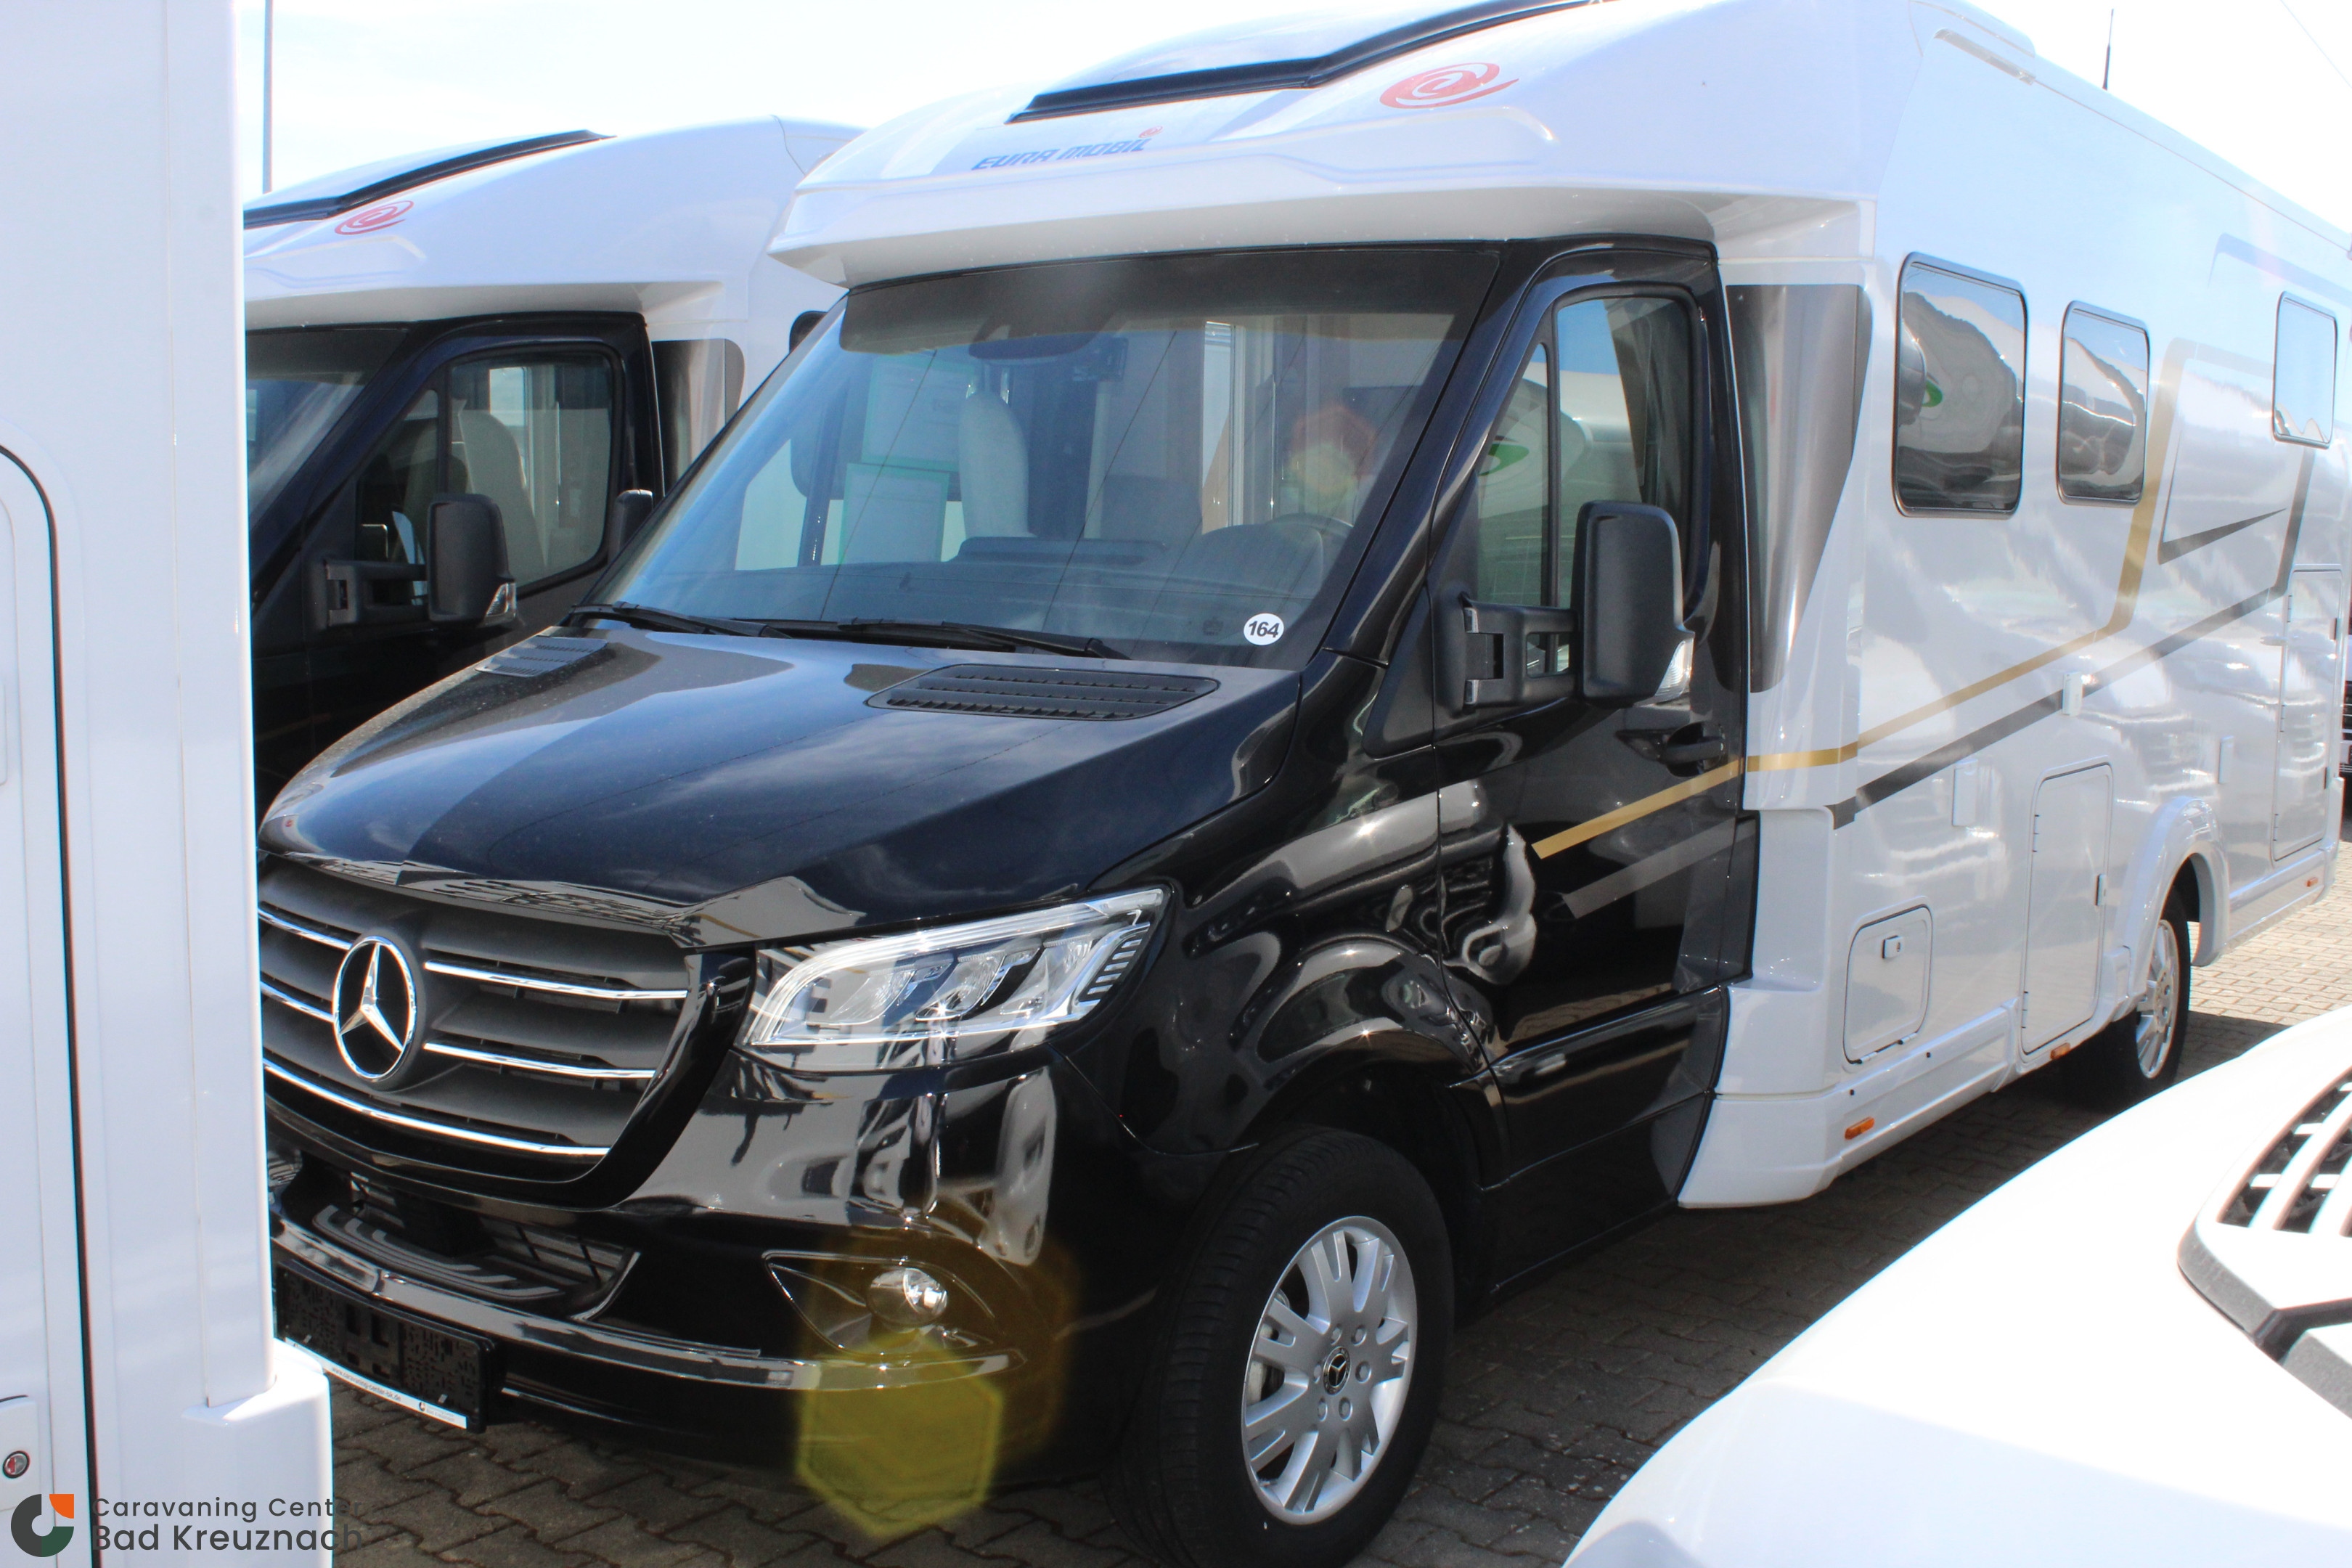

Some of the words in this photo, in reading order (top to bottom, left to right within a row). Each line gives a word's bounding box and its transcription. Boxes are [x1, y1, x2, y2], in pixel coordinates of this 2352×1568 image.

[971, 148, 1061, 171] EURA
[1058, 138, 1152, 160] MOBIL
[1249, 621, 1280, 638] 164
